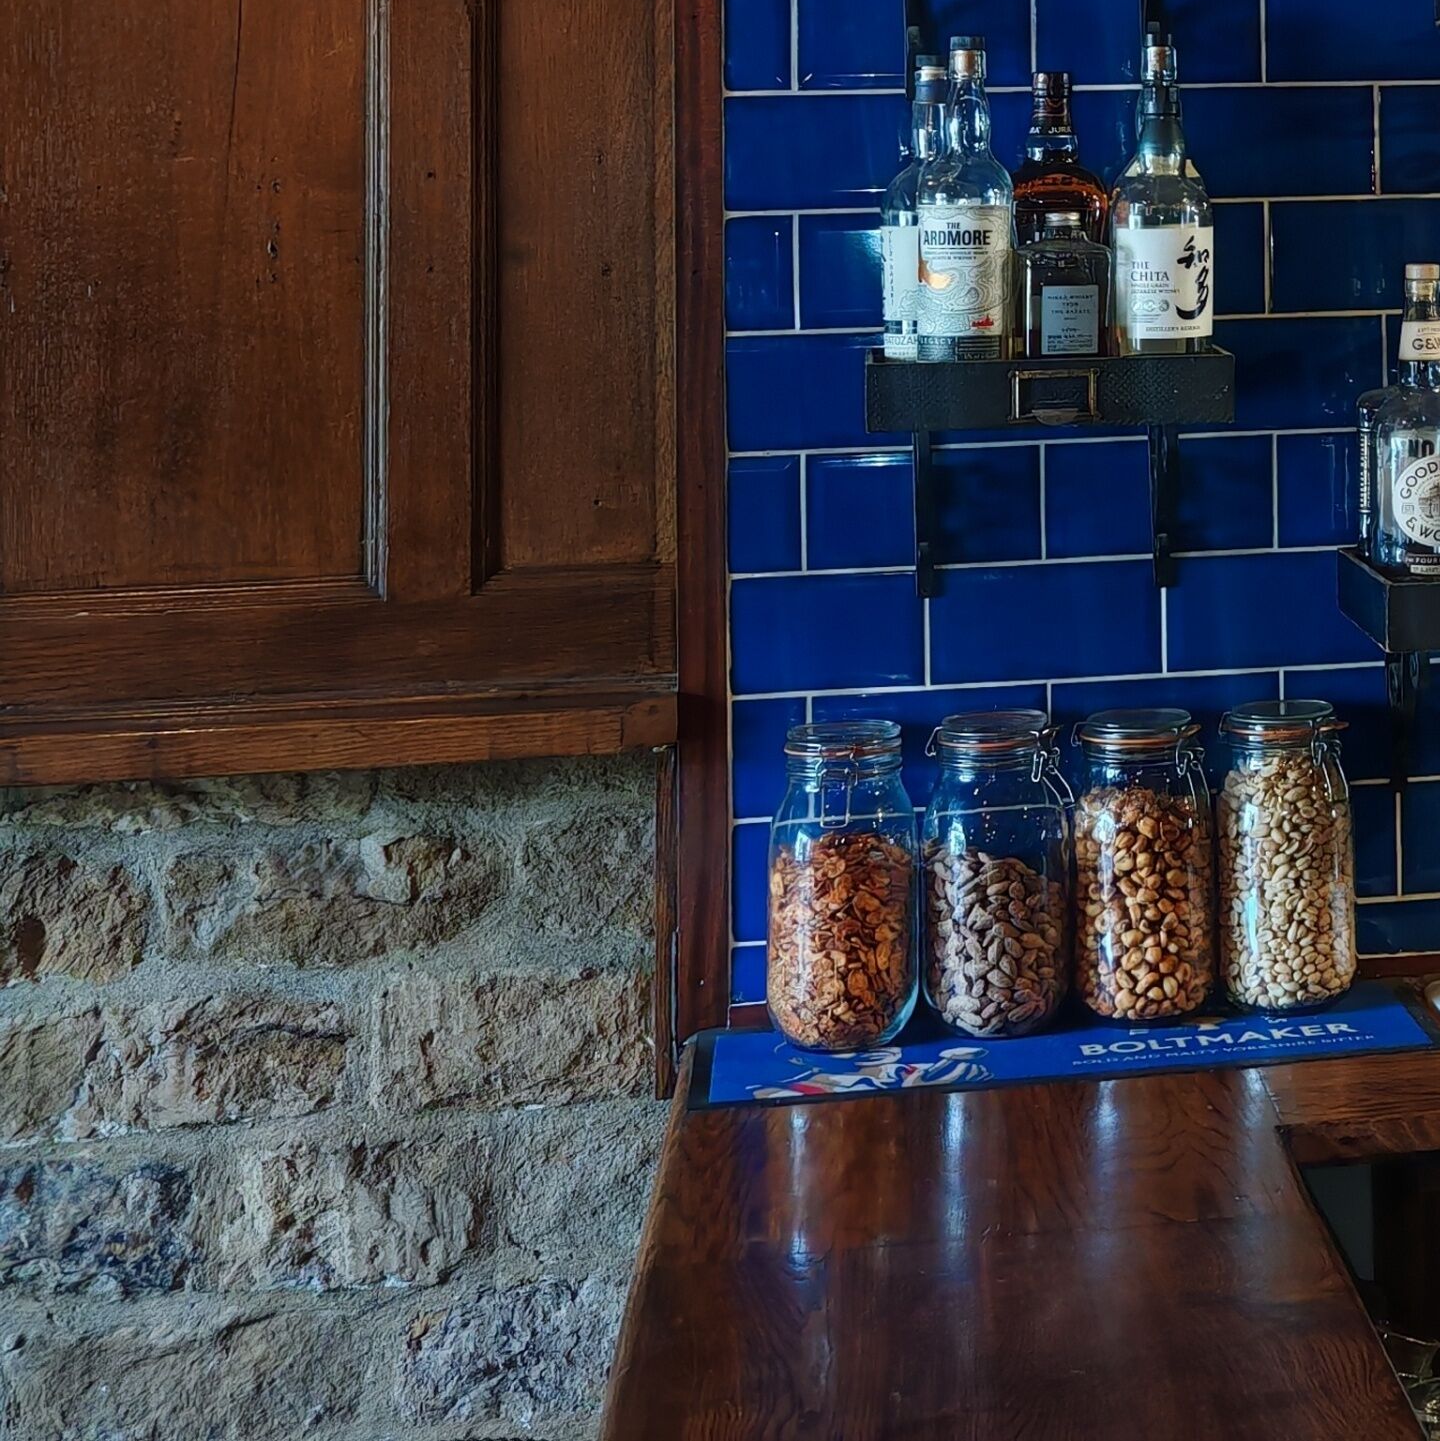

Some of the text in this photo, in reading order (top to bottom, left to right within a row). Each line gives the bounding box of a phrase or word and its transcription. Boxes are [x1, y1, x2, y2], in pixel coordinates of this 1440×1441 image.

[923, 229, 993, 246] ARDMORE
[1131, 261, 1150, 270] THE
[1130, 270, 1170, 282] CHITA
[1079, 1023, 1359, 1057] BOLTMAKER
